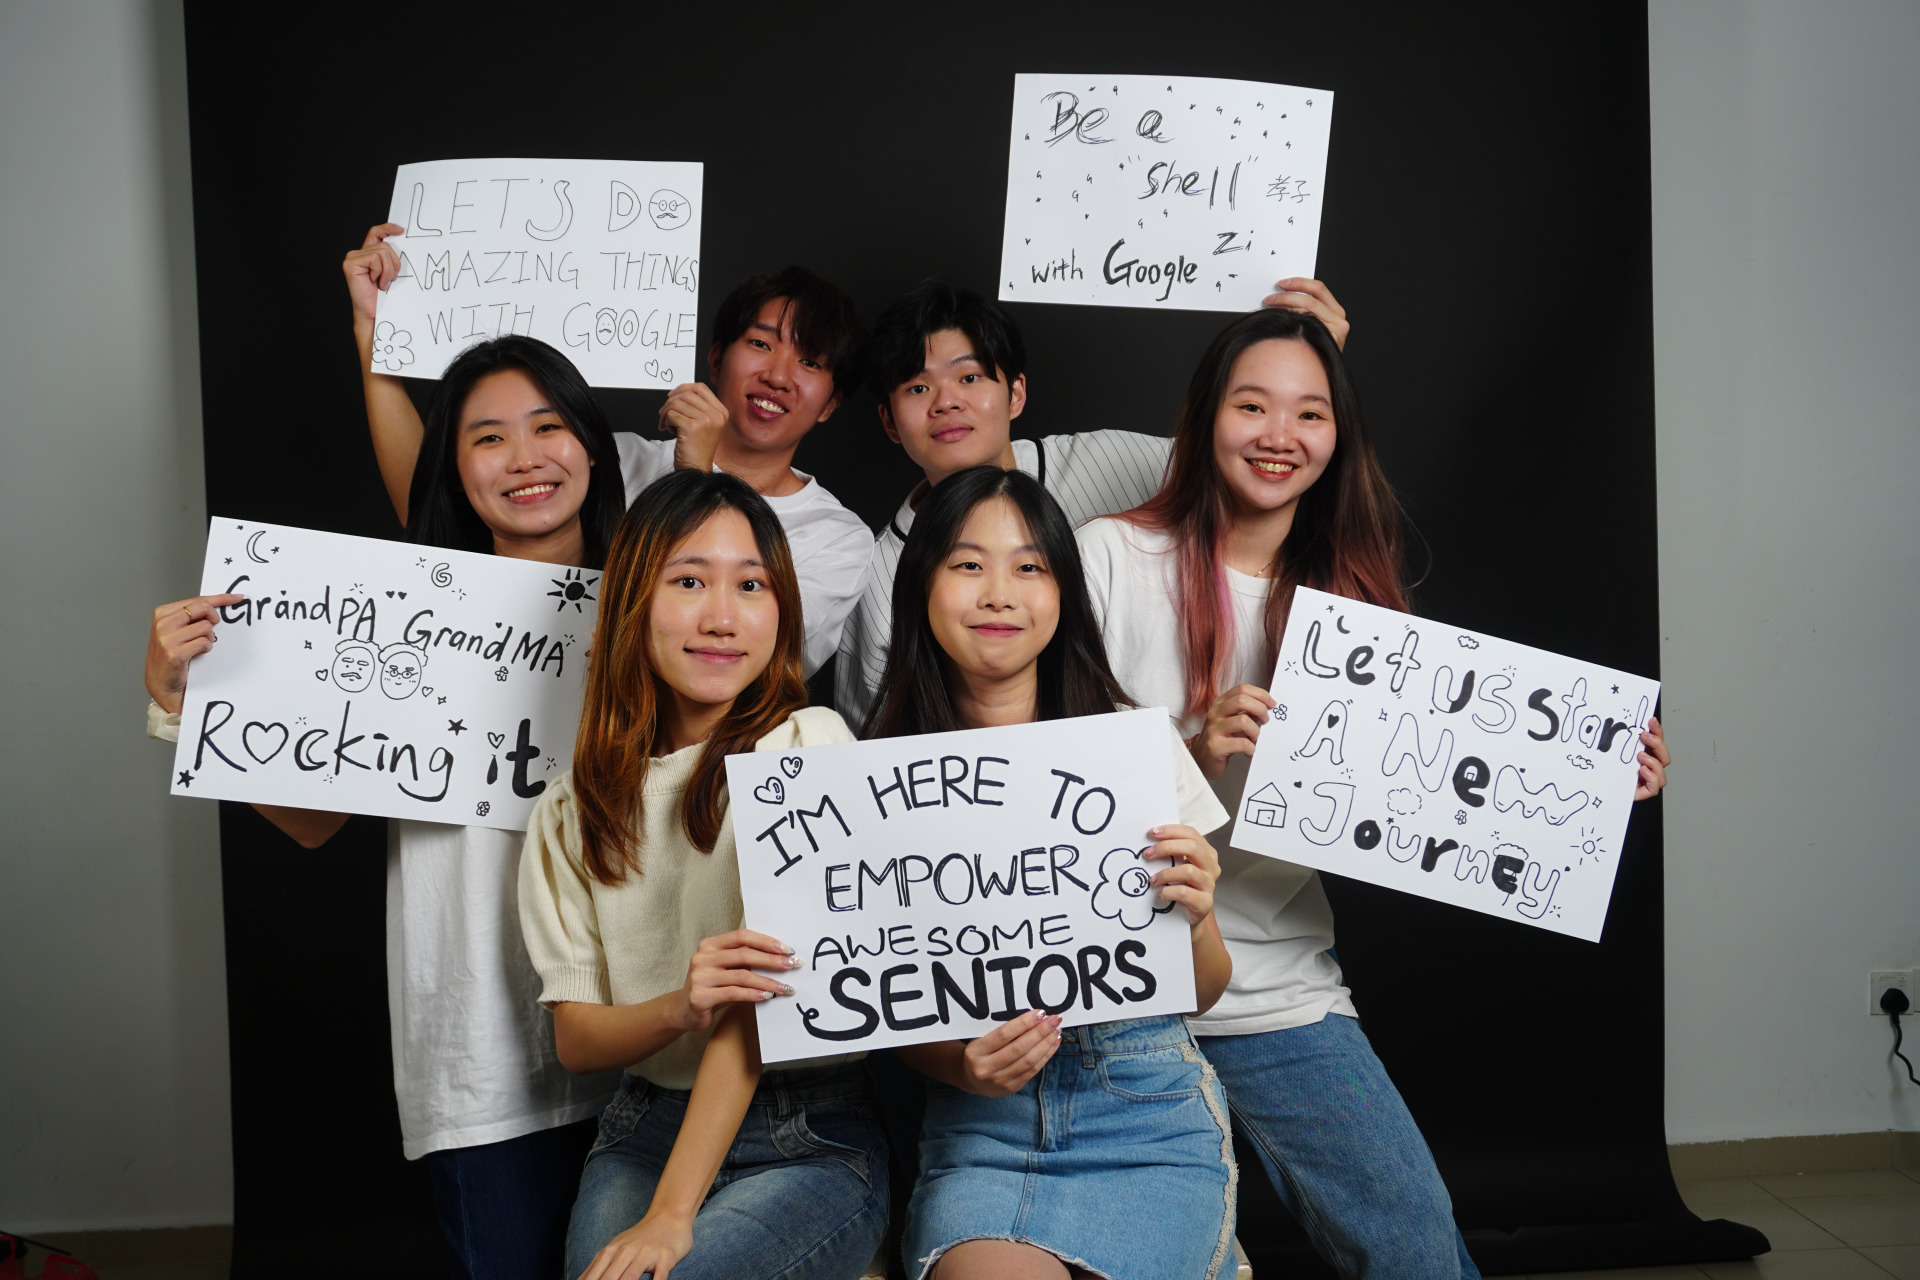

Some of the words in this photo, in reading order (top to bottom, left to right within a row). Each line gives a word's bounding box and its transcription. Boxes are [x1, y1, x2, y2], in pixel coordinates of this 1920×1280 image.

[1040, 91, 1117, 148] Be
[1136, 110, 1176, 143] a
[404, 178, 574, 242] LET'S
[1266, 174, 1311, 203] 孝子
[386, 250, 579, 293] AMAZING
[599, 251, 698, 292] THINGS
[1031, 248, 1083, 283] with
[1103, 238, 1198, 301] Google
[1212, 229, 1254, 255] Zi
[427, 302, 534, 345] WITH
[562, 302, 696, 352] GOOGLE
[1303, 620, 1421, 694] Let
[486, 718, 547, 799] it
[1299, 700, 1348, 765] A
[755, 794, 852, 876] I'M
[867, 755, 1010, 819] HERE
[1050, 769, 1116, 835] TO
[825, 844, 1091, 912] EMPOWER
[811, 914, 1073, 971] AWESOME
[797, 939, 1157, 1041] SENIORS
